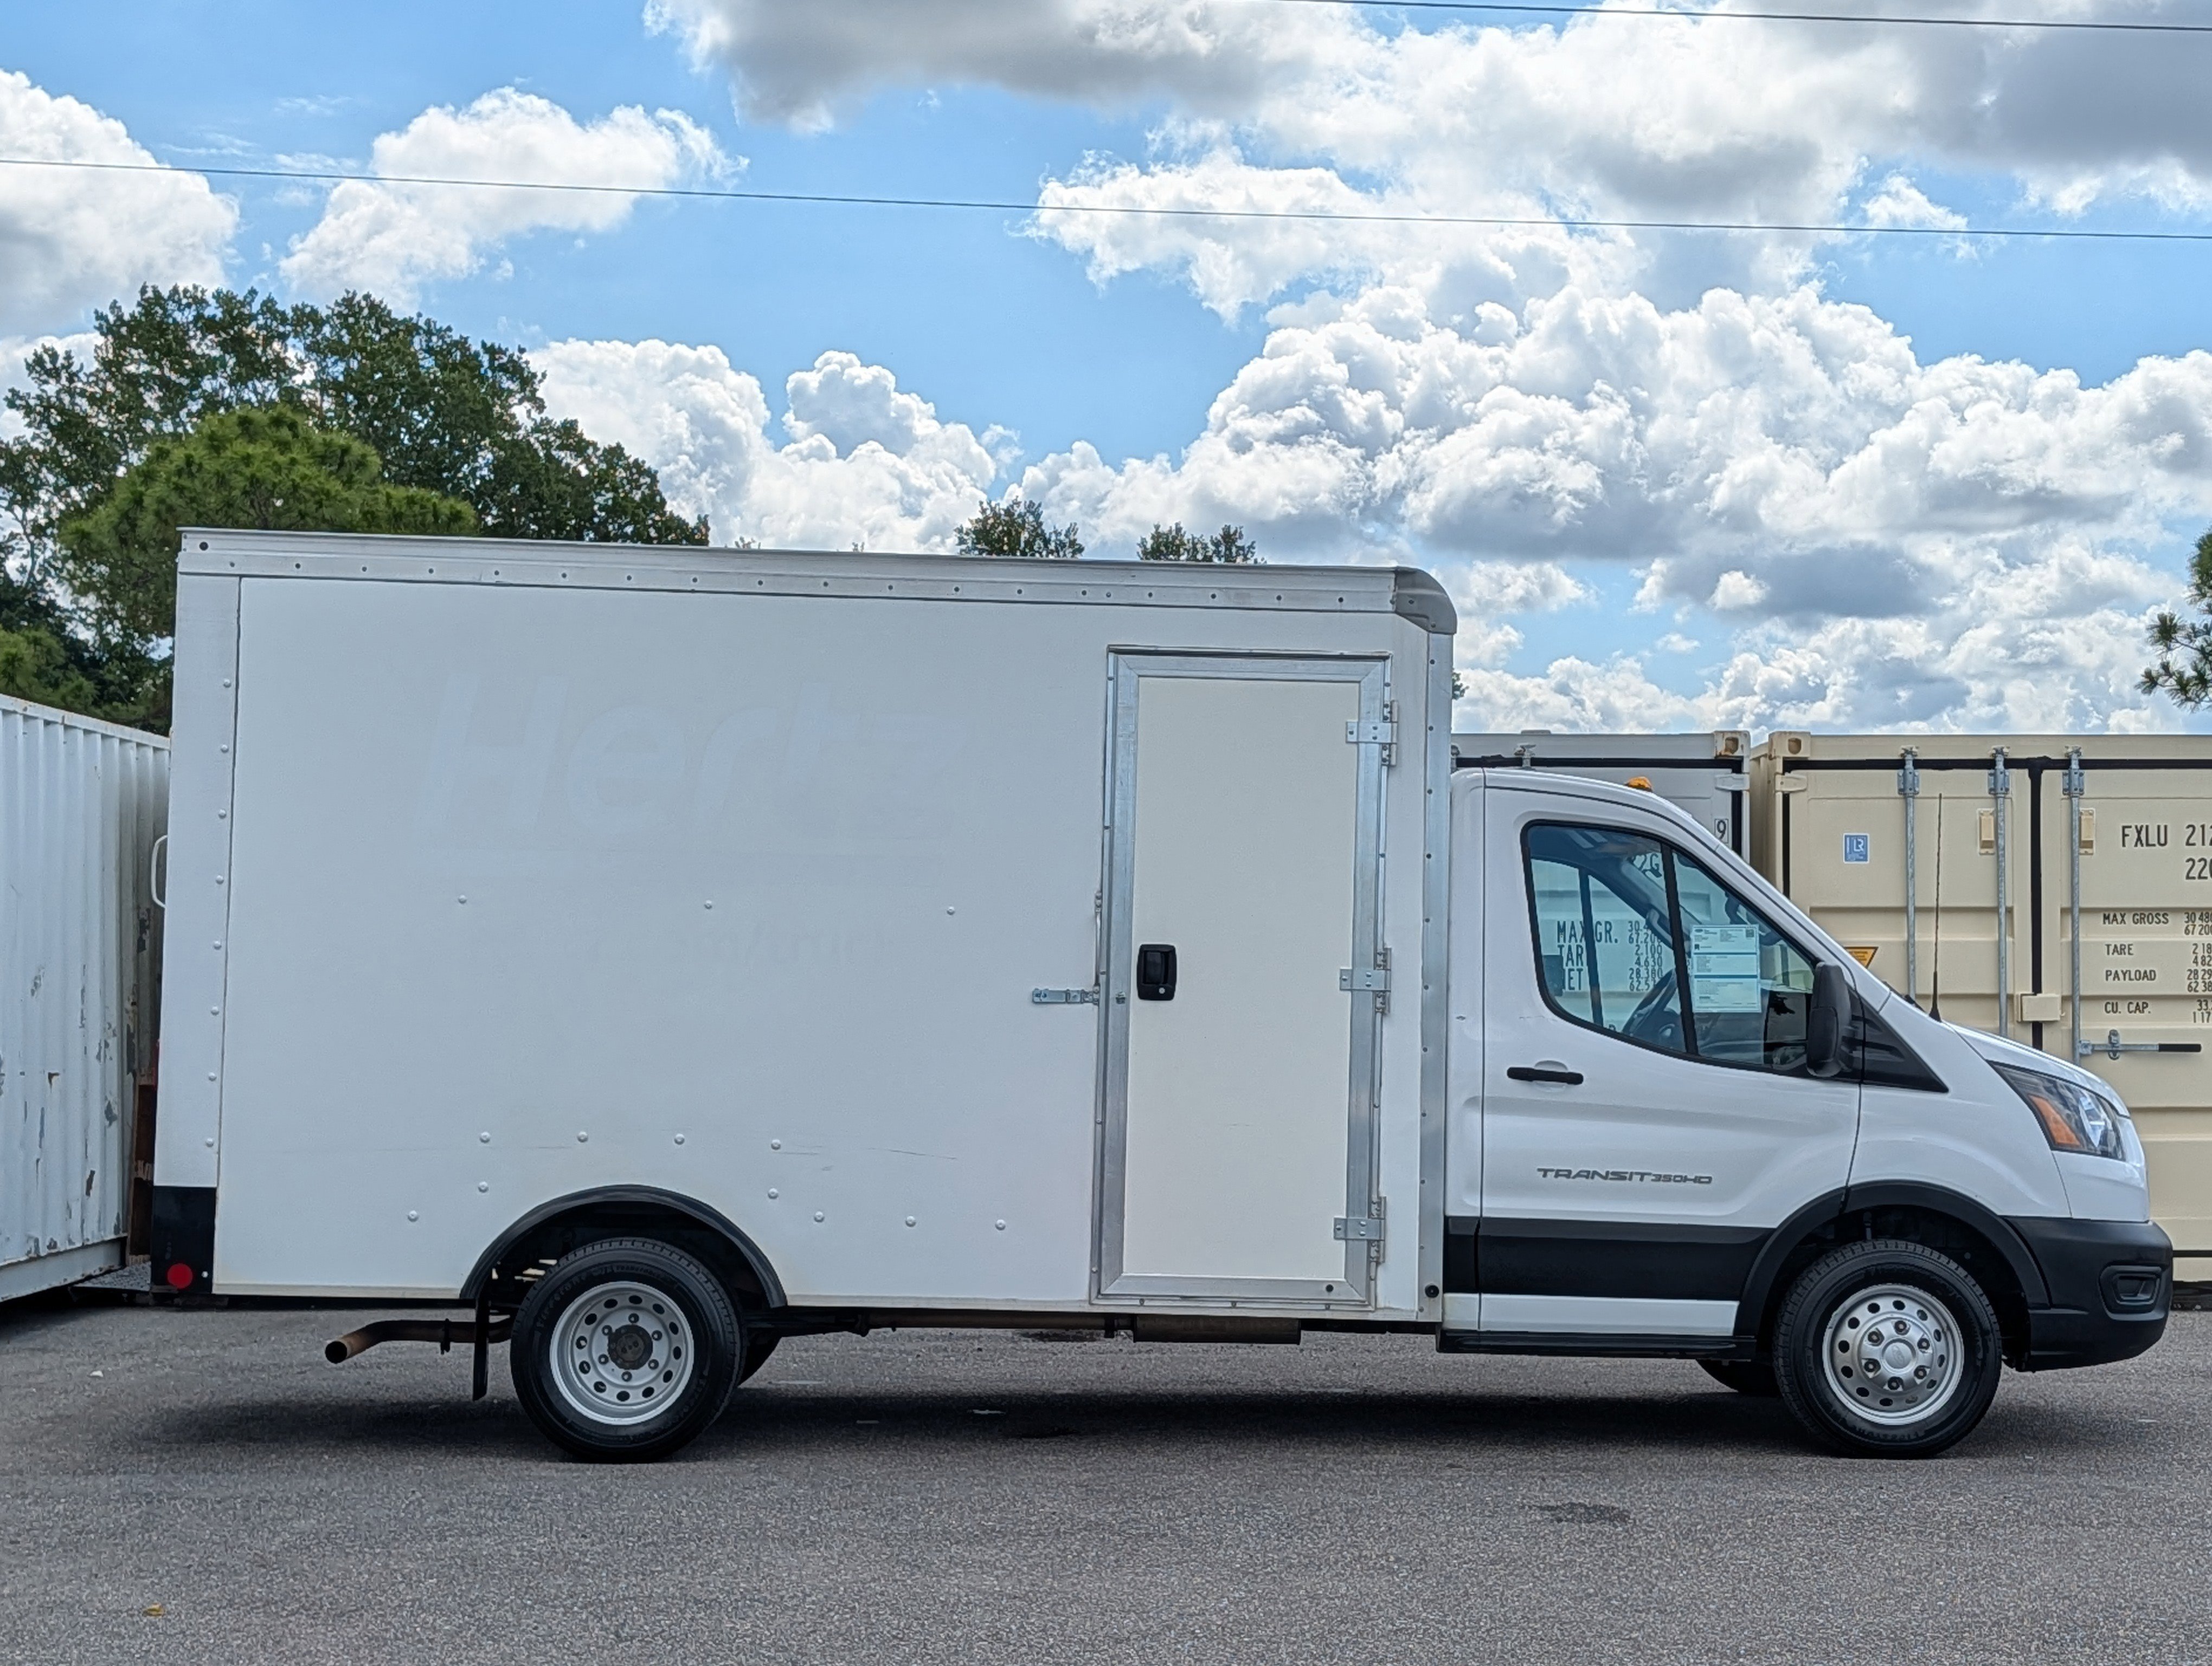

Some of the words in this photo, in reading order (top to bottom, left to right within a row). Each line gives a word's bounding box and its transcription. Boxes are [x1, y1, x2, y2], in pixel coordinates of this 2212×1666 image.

[1716, 819, 1726, 840] 9
[2121, 824, 2168, 847] FXLU
[2185, 823, 2212, 846] 21
[2185, 857, 2212, 880] 22
[2102, 912, 2126, 925] MAX
[2132, 912, 2169, 925] GROSS
[1594, 920, 1618, 943] GR.
[2105, 944, 2134, 955] TARE
[1562, 968, 1584, 990] ET
[2105, 970, 2157, 981] PAYLOAD
[2104, 1002, 2121, 1014] CU.
[2127, 1002, 2151, 1014] CAP.
